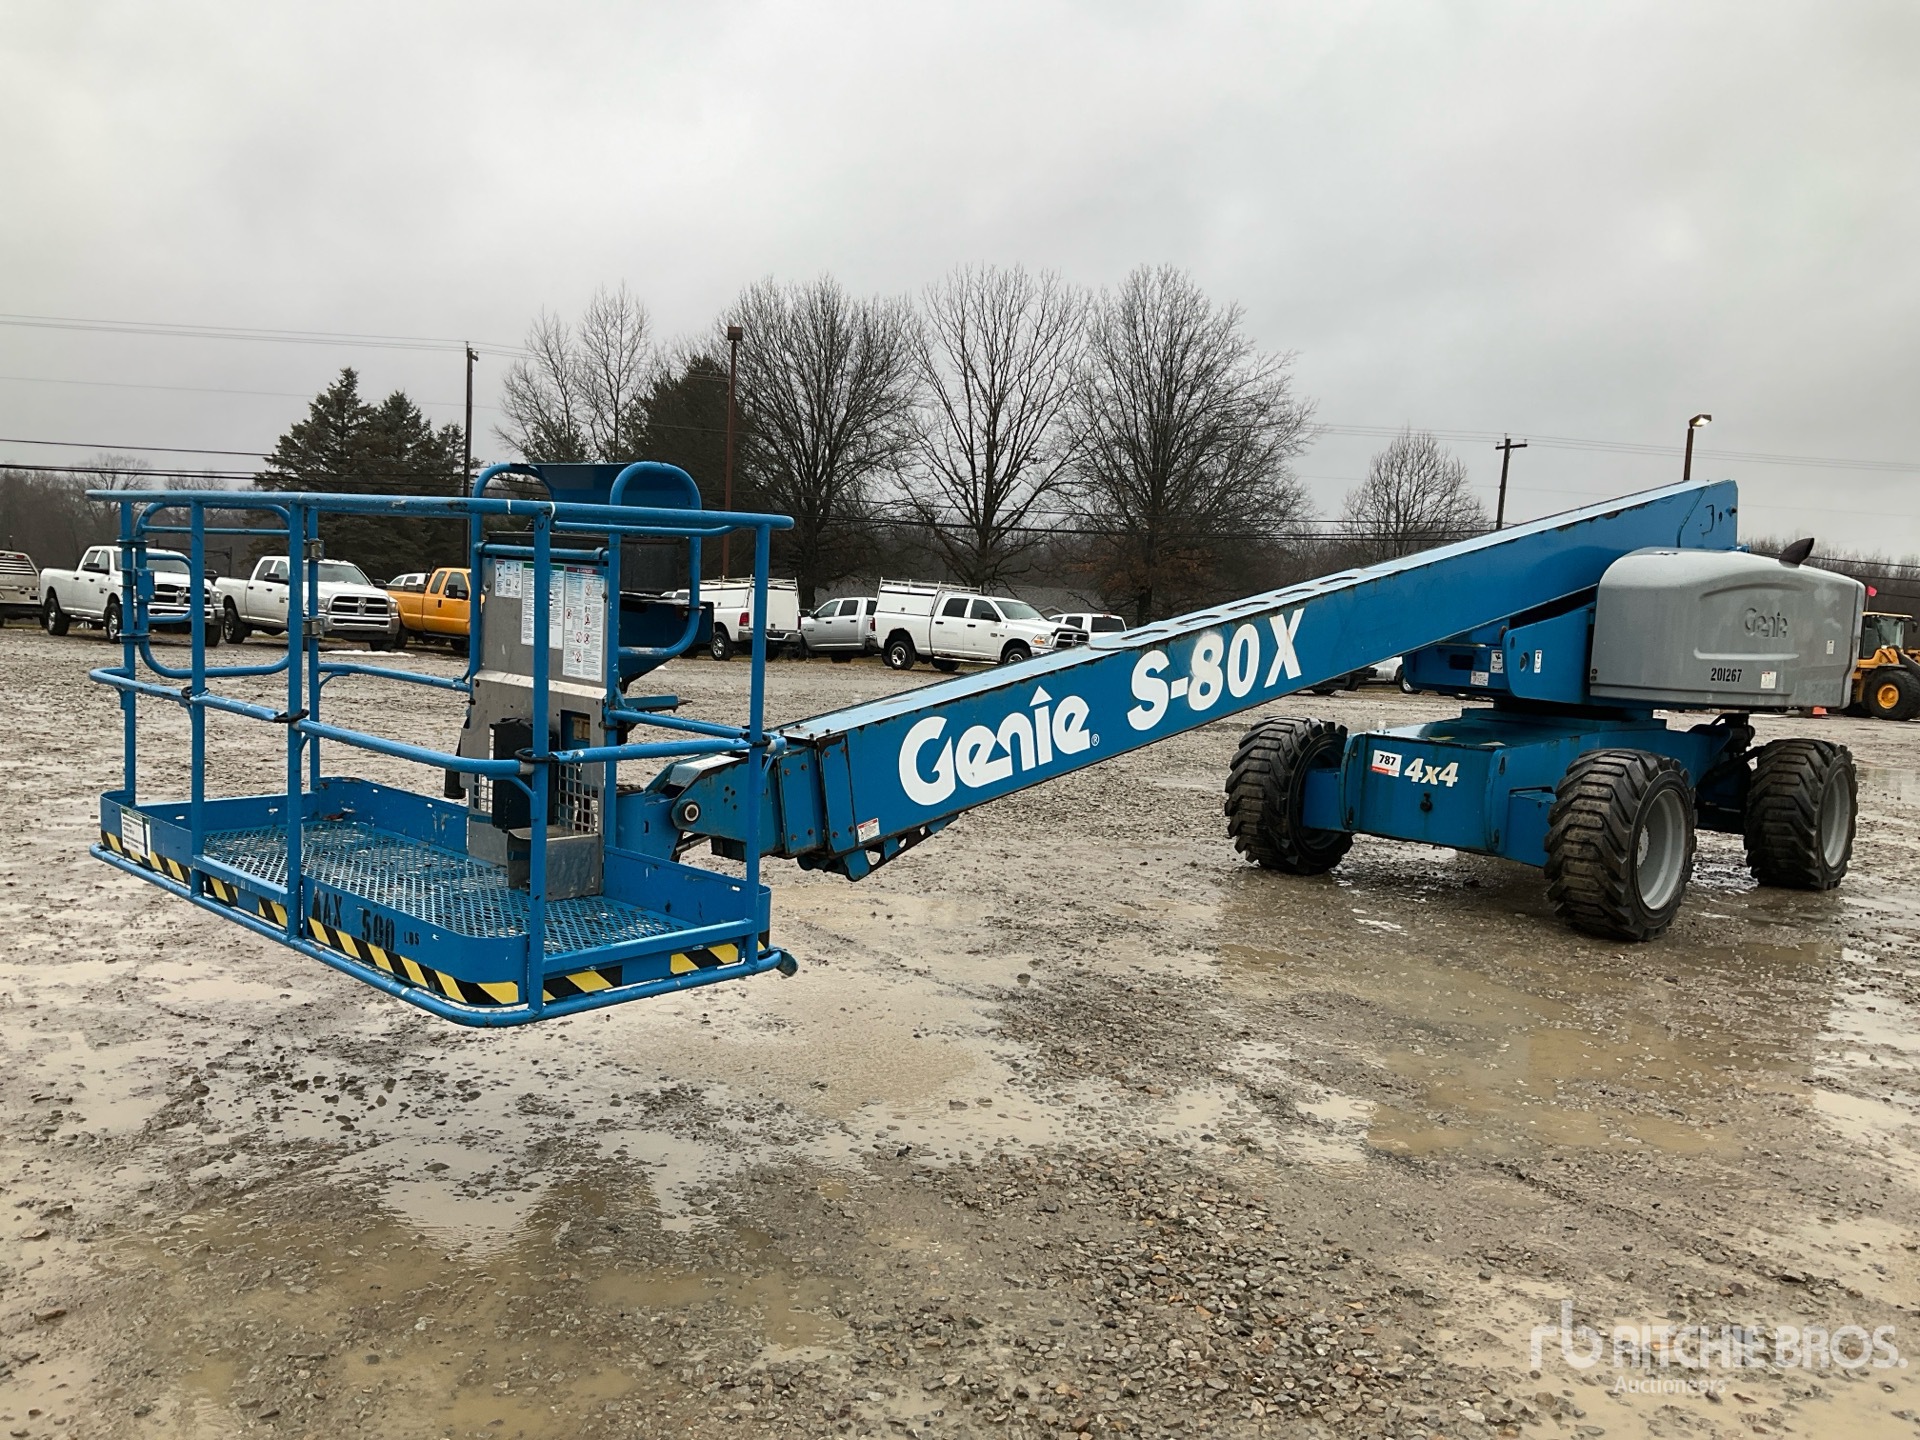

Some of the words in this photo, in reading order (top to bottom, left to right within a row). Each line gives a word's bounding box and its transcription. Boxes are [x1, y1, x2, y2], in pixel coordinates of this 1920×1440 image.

[1745, 607, 1788, 637] Genie
[1711, 667, 1742, 682] 201267
[899, 685, 1090, 806] Genie
[1379, 754, 1396, 766] 787
[1404, 758, 1458, 787] 4x4
[362, 909, 394, 951] 500
[404, 931, 419, 945] LBS
